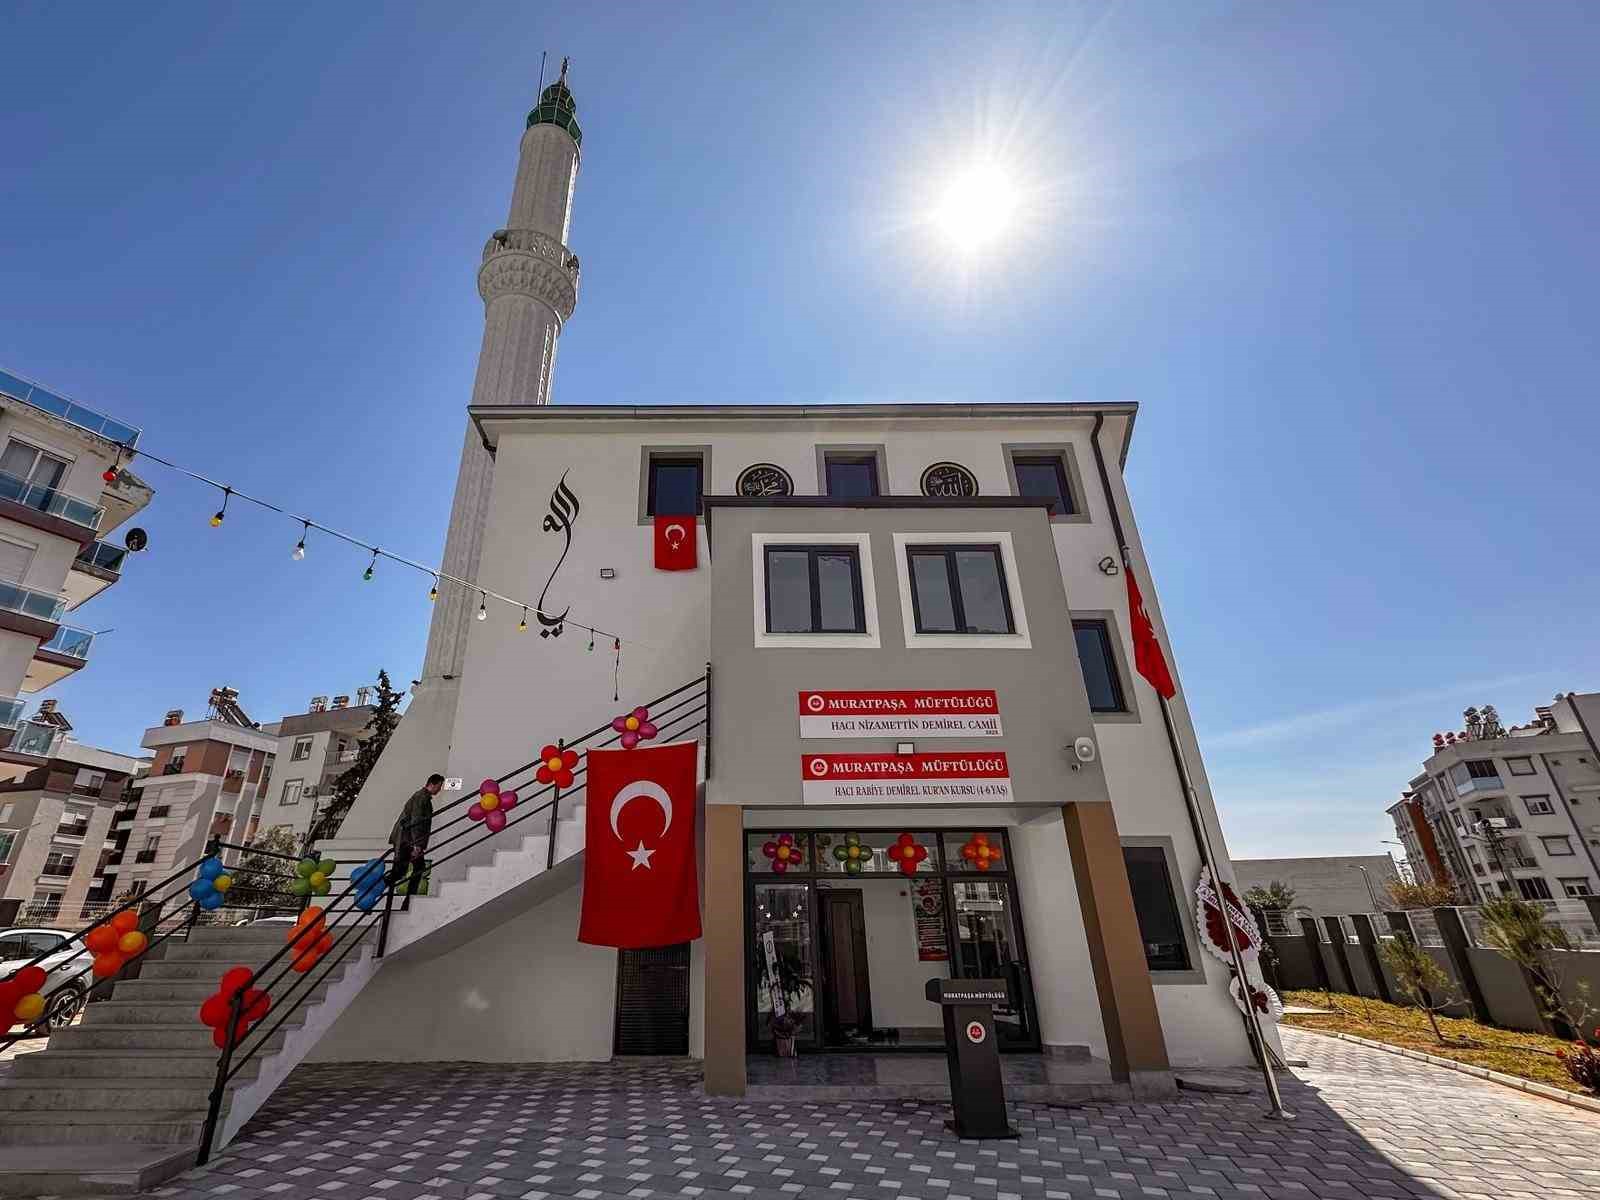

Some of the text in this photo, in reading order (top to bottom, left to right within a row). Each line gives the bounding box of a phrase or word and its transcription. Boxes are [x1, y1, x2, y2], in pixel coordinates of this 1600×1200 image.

[828, 696, 993, 711] MURATPAŞA MÜFTÜLÜĞÜ
[831, 718, 997, 730] HACI NİZAMETTİN DEMİREL CAMİİ
[832, 759, 1004, 775] MURATPAŞA MÜFTÜLÜĞÜ
[834, 786, 854, 797] HACI
[855, 784, 885, 797] RABİYE
[886, 784, 921, 796] DEMİREL
[950, 784, 976, 796] KURSU
